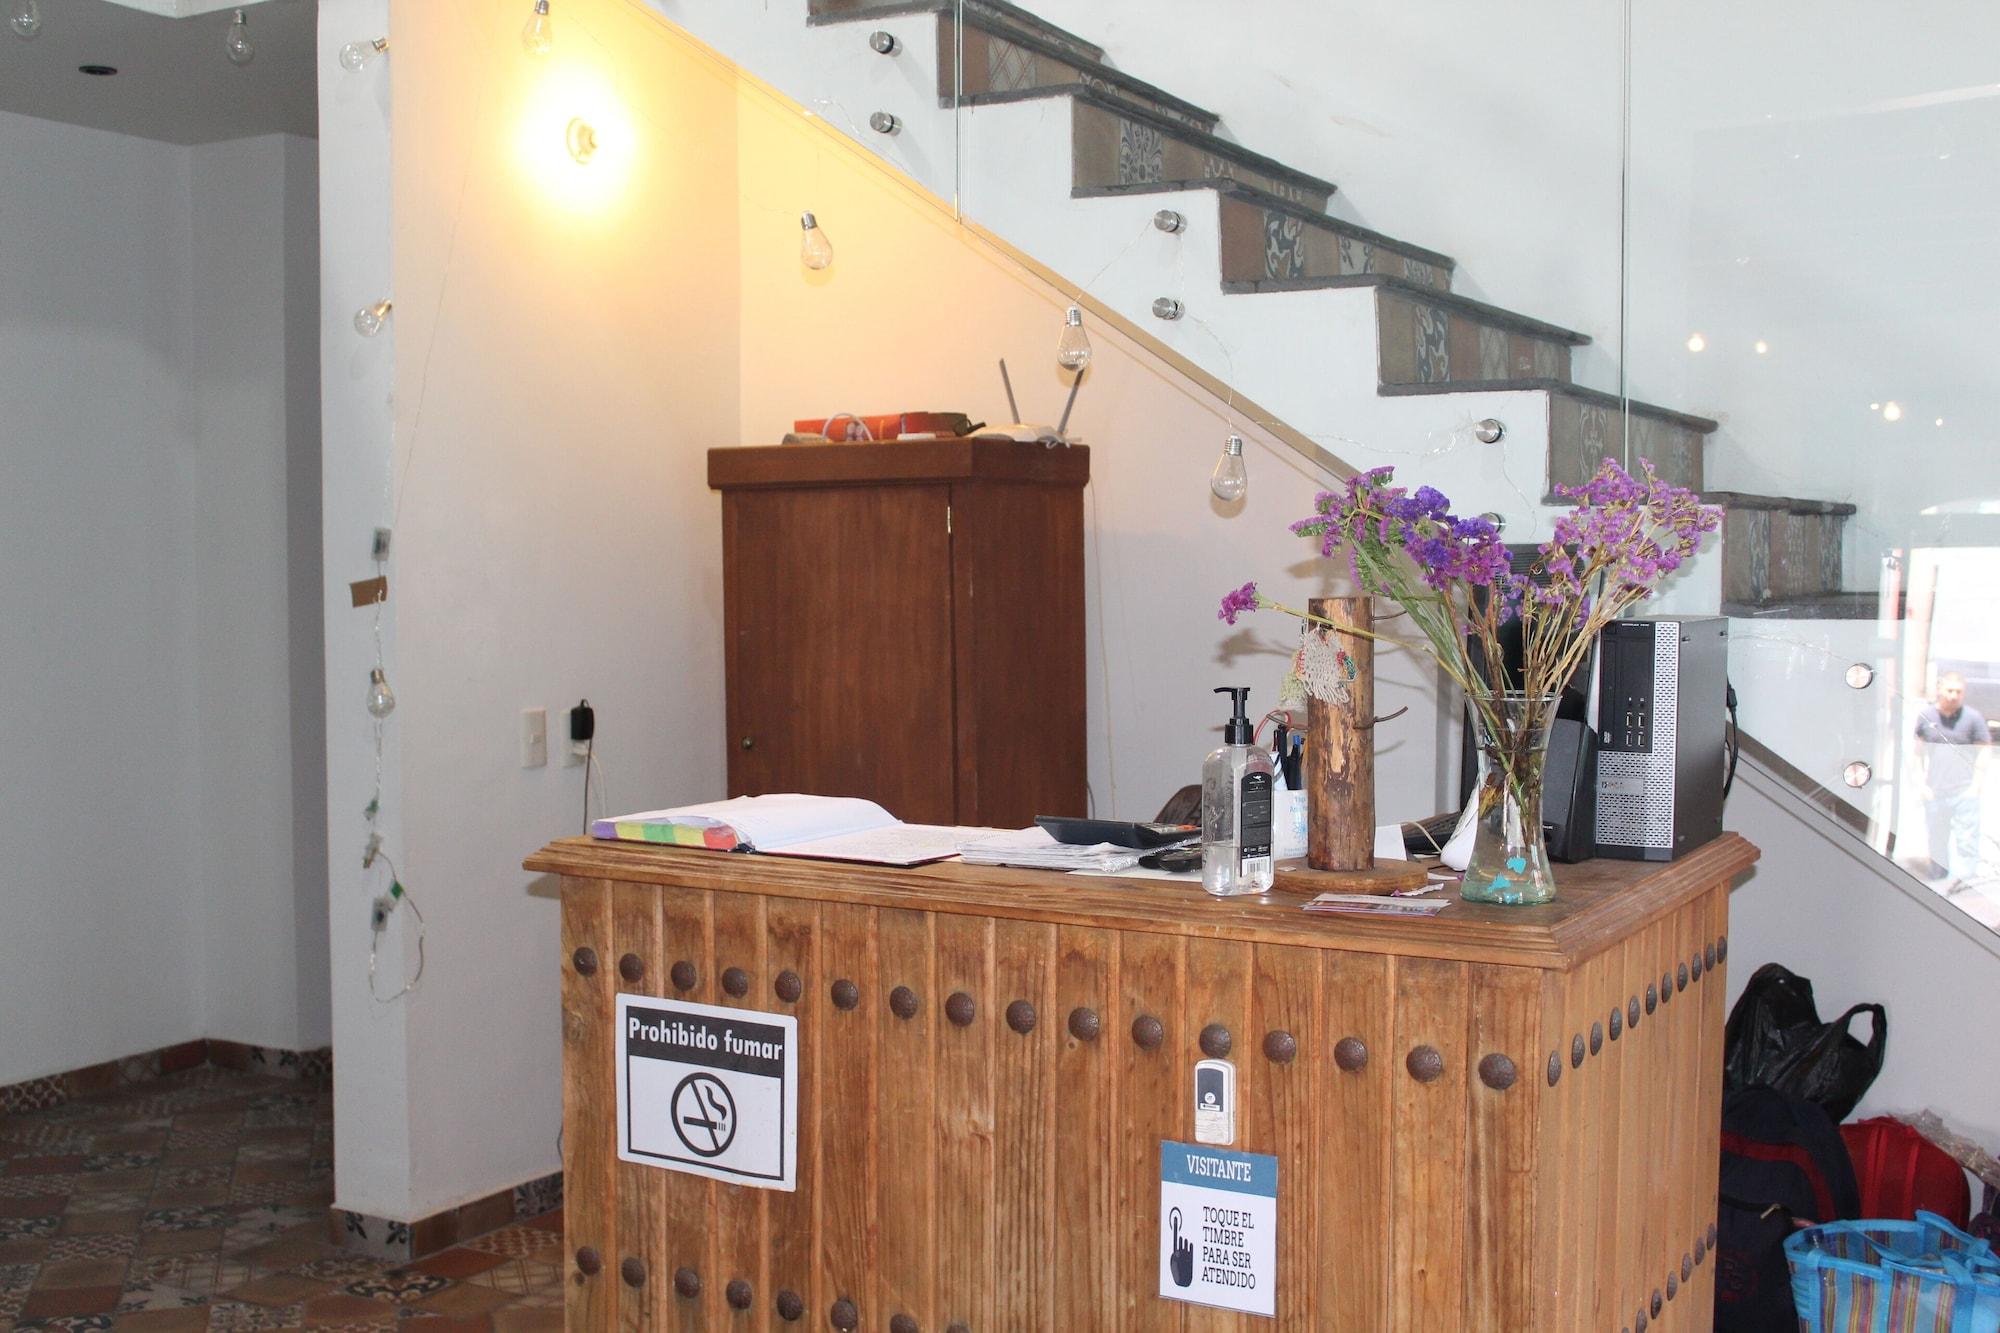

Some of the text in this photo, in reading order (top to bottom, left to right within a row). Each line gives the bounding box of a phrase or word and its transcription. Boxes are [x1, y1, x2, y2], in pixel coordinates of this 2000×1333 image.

[629, 1017, 783, 1060] Prohibido fumar
[1186, 1154, 1251, 1182] VISITANTE
[1203, 1206, 1254, 1229] TOQUE EL
[1203, 1226, 1244, 1247] TIMBRE
[1203, 1246, 1251, 1269] PARA SER
[1201, 1266, 1256, 1290] ATENDIDO
